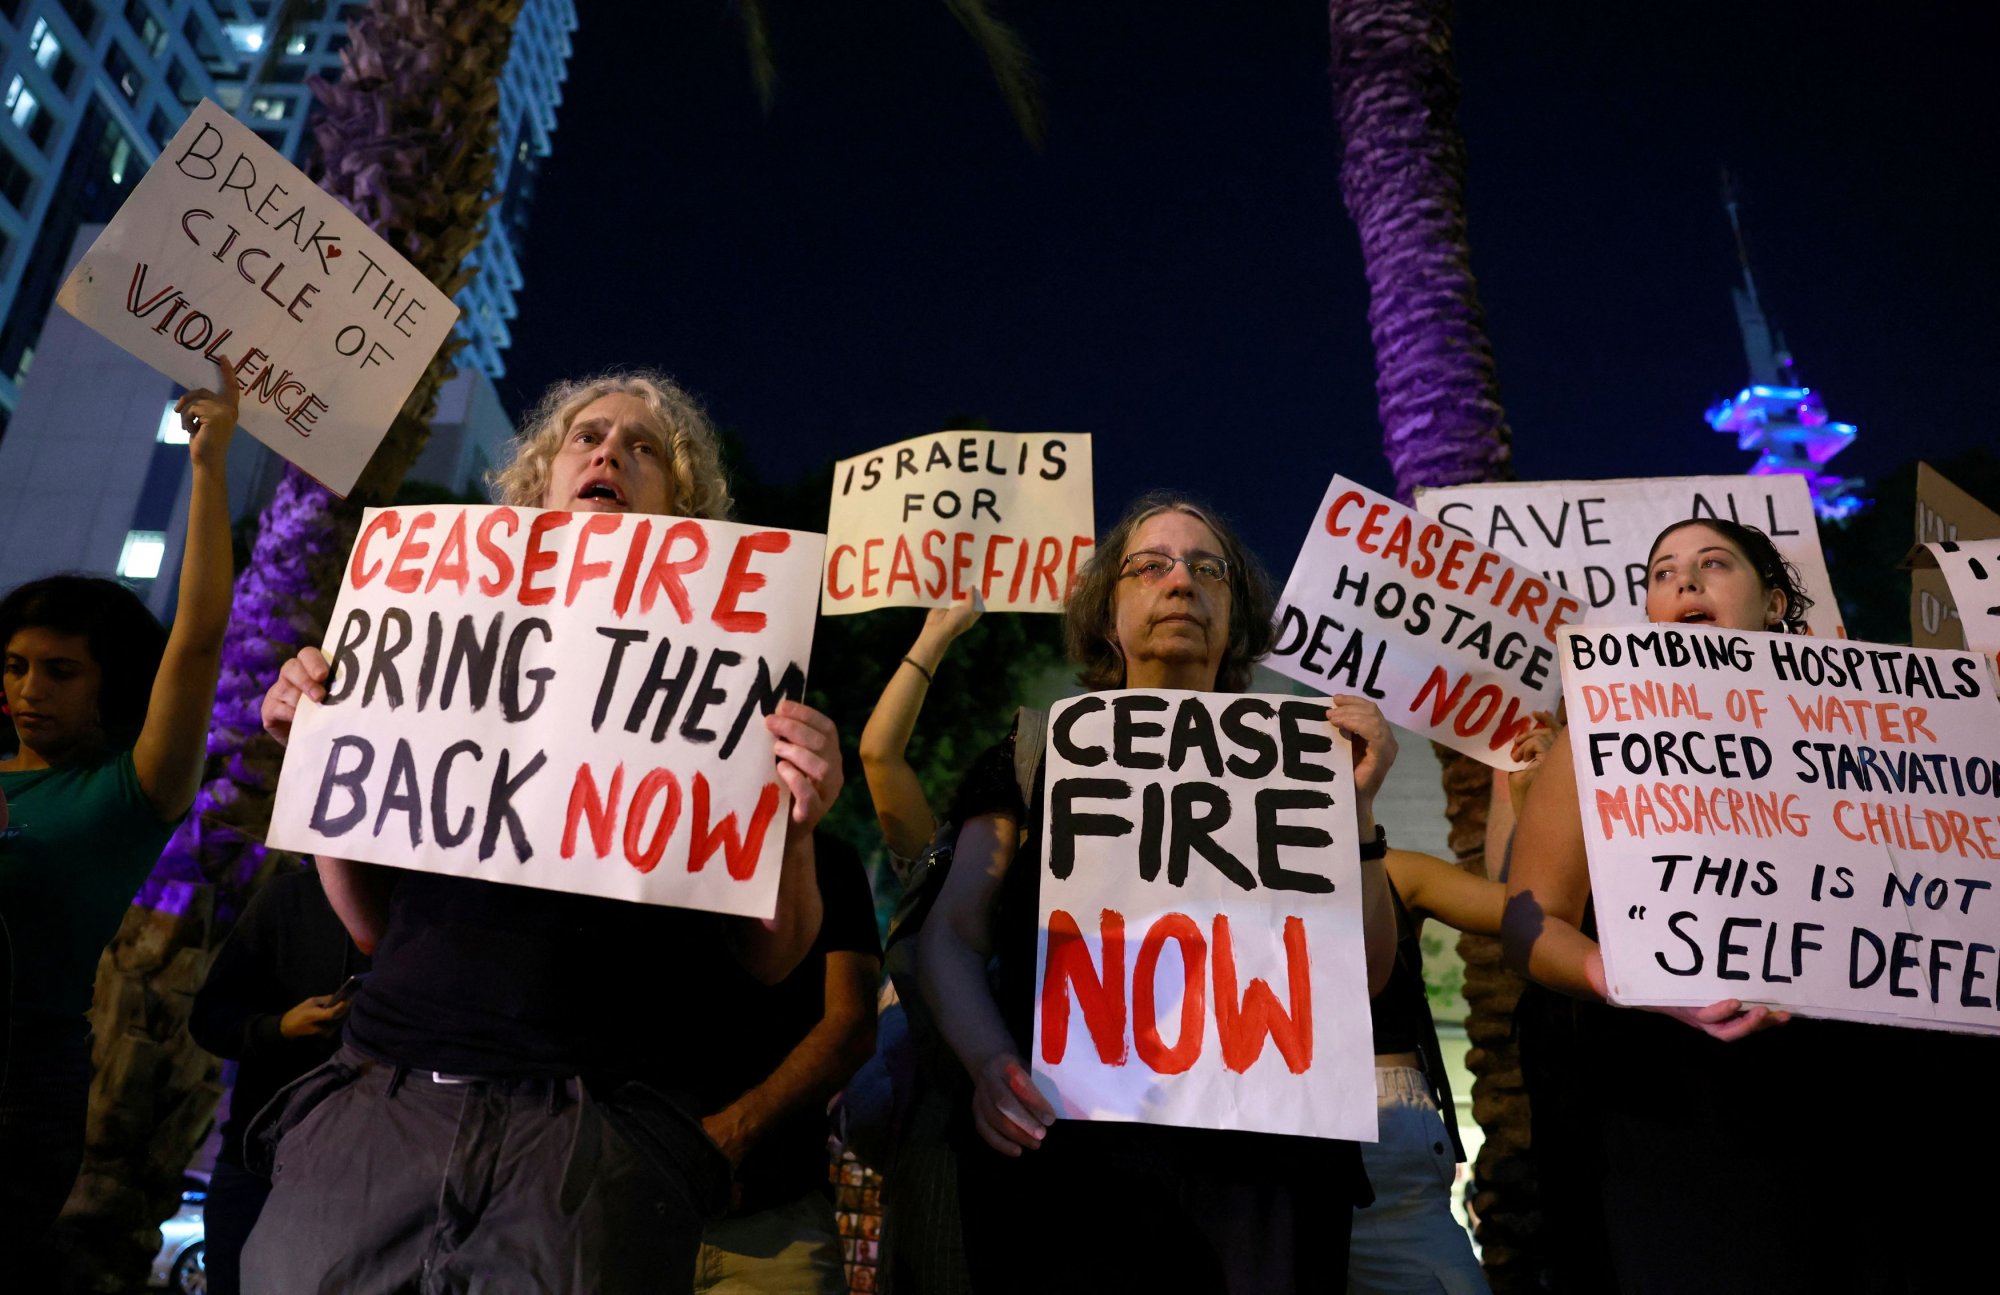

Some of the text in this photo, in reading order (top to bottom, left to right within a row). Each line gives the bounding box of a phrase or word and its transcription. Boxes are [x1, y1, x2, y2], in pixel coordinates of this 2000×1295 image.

[175, 122, 427, 337] BREAK THE
[181, 208, 395, 370] CICLE OF
[126, 262, 329, 438] VIOLENCE
[843, 438, 1066, 495] ISRAELIS
[902, 489, 1000, 522] FOR
[350, 506, 791, 633] CEASEFIRE
[1325, 491, 1579, 642] CEASEFIRE
[1438, 498, 1611, 548] SAVE
[1272, 604, 1387, 700] DEAL
[1333, 564, 1553, 692] HOSTAGE
[1569, 631, 1754, 671] BOMBING
[1770, 640, 1981, 699] HOSPITALS
[324, 607, 805, 760] BRING THEM
[1581, 680, 1937, 744] DENIAL OF WATER
[1053, 696, 1335, 782] CEASE
[1589, 731, 1772, 780] FORCED
[309, 735, 780, 881] BACK NOW
[1049, 778, 1335, 893] FIRE
[1595, 783, 2000, 860] MASSACRING CHILDRE
[1652, 855, 1991, 914] THIS IS NOT
[1042, 908, 1313, 1075] NOW
[1849, 926, 2000, 1012] DEFE
